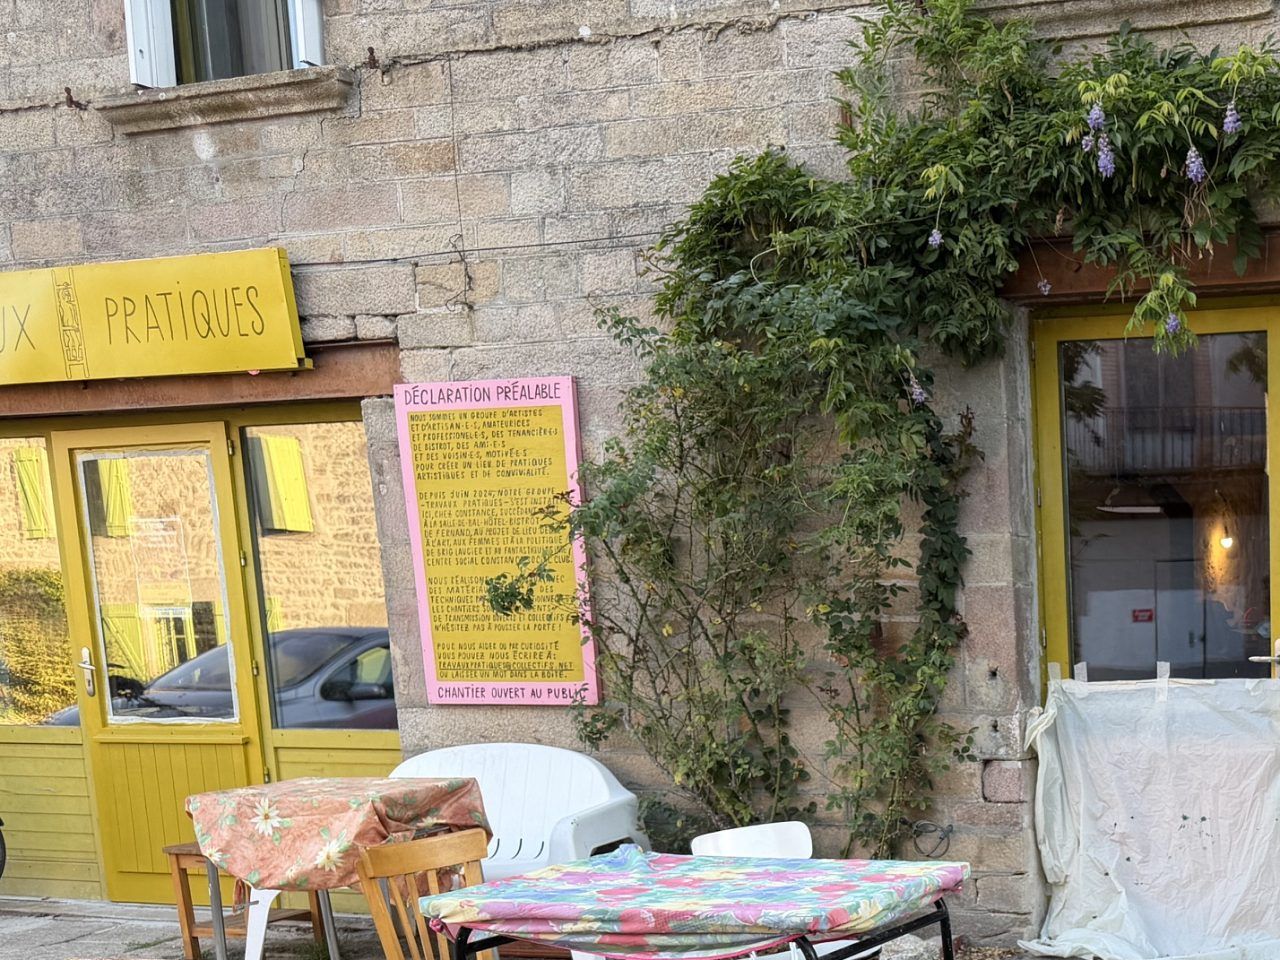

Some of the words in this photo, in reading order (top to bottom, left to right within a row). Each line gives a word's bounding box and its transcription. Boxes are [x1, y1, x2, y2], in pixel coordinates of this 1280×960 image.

[105, 282, 266, 346] PRATIQUES
[404, 384, 491, 406] DÉCLARATION
[496, 381, 561, 401] PRÉALABLE
[438, 684, 486, 699] CHANTIER
[492, 687, 526, 699] OUVERT
[531, 688, 542, 698] AU
